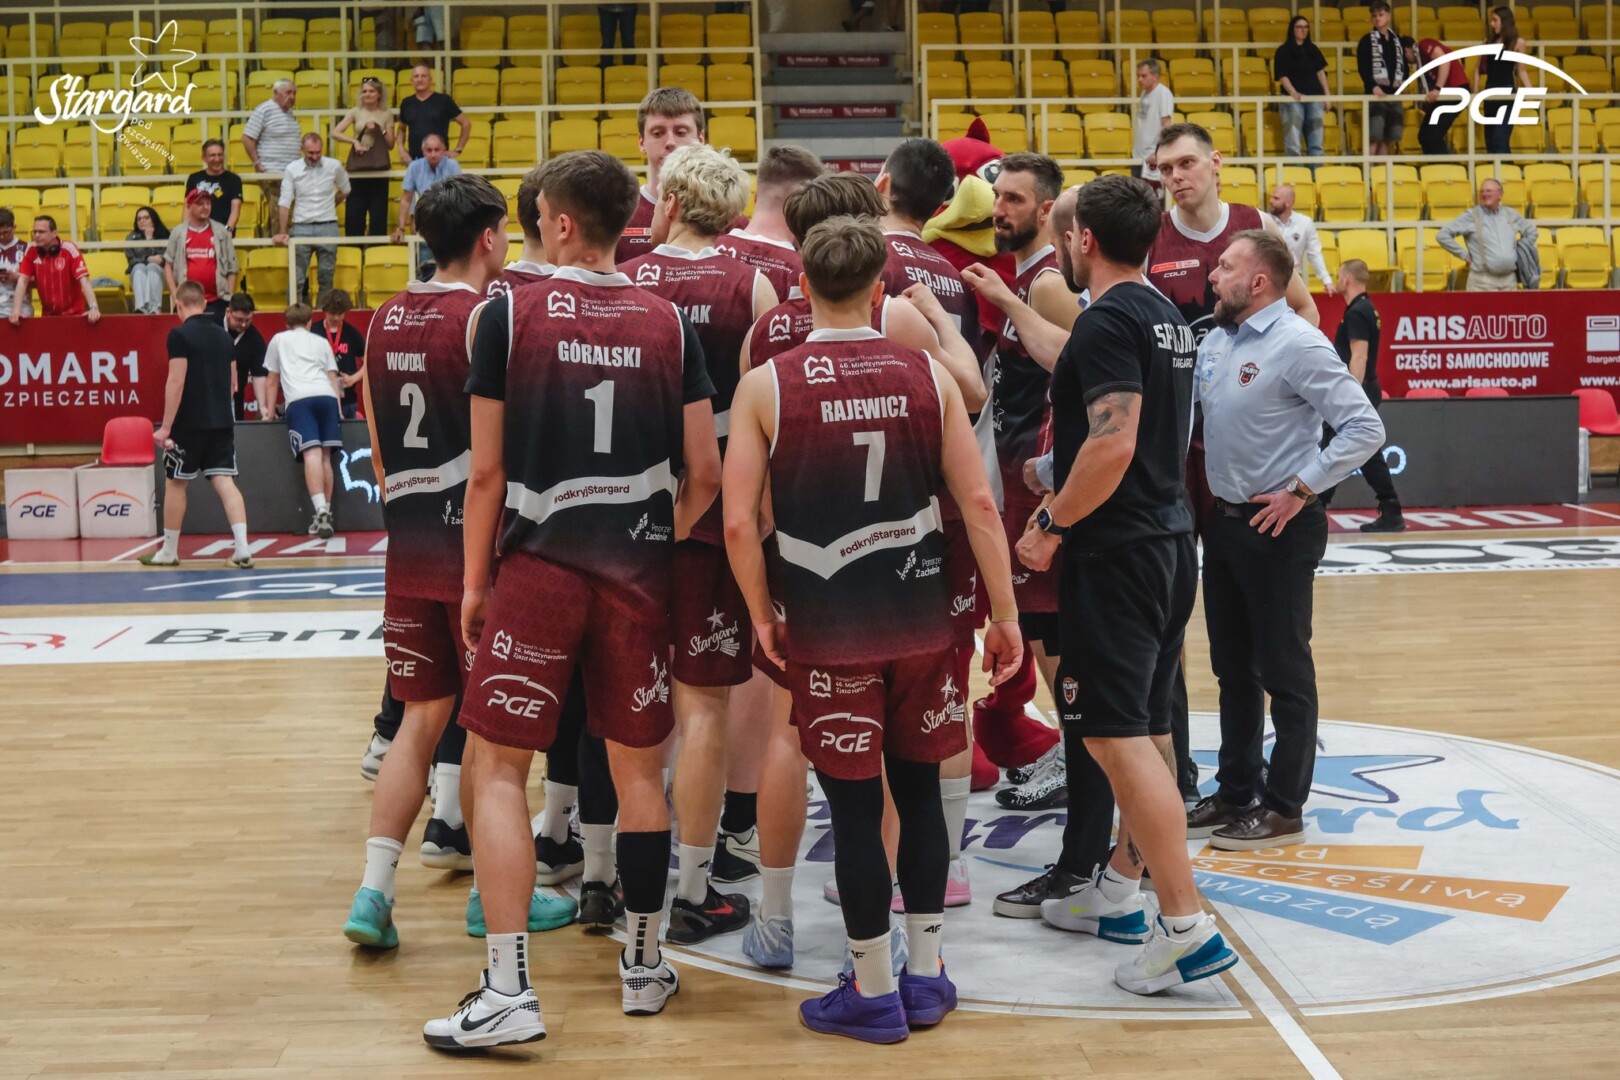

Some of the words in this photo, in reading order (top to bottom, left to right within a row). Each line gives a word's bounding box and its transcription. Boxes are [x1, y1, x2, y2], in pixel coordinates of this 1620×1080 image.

[592, 305, 648, 313] Międzynarodowy
[1394, 314, 1547, 341] ARISAUTO
[557, 339, 641, 368] GÓRALSKI
[851, 360, 908, 370] Międzynarodowy
[1395, 350, 1441, 373] CZĘŚCI
[1446, 352, 1549, 370] SAMOCHODOWE
[860, 368, 882, 376] Hanzy
[1408, 375, 1537, 389] www.arisauto.pl
[400, 383, 428, 448] 2
[584, 380, 615, 454] 1
[820, 396, 909, 423] RAJEWICZ
[853, 431, 886, 502] 7
[553, 485, 630, 504] #odkryjStargard
[20, 504, 57, 518] PGE
[94, 503, 132, 517] PGE
[839, 526, 916, 557] #odkryjStargard
[688, 620, 739, 657] Stargard
[487, 690, 545, 719] PGE
[820, 731, 873, 753] PGE
[1192, 857, 1526, 908] szczęśliwą
[1193, 874, 1400, 929] wiazdą
